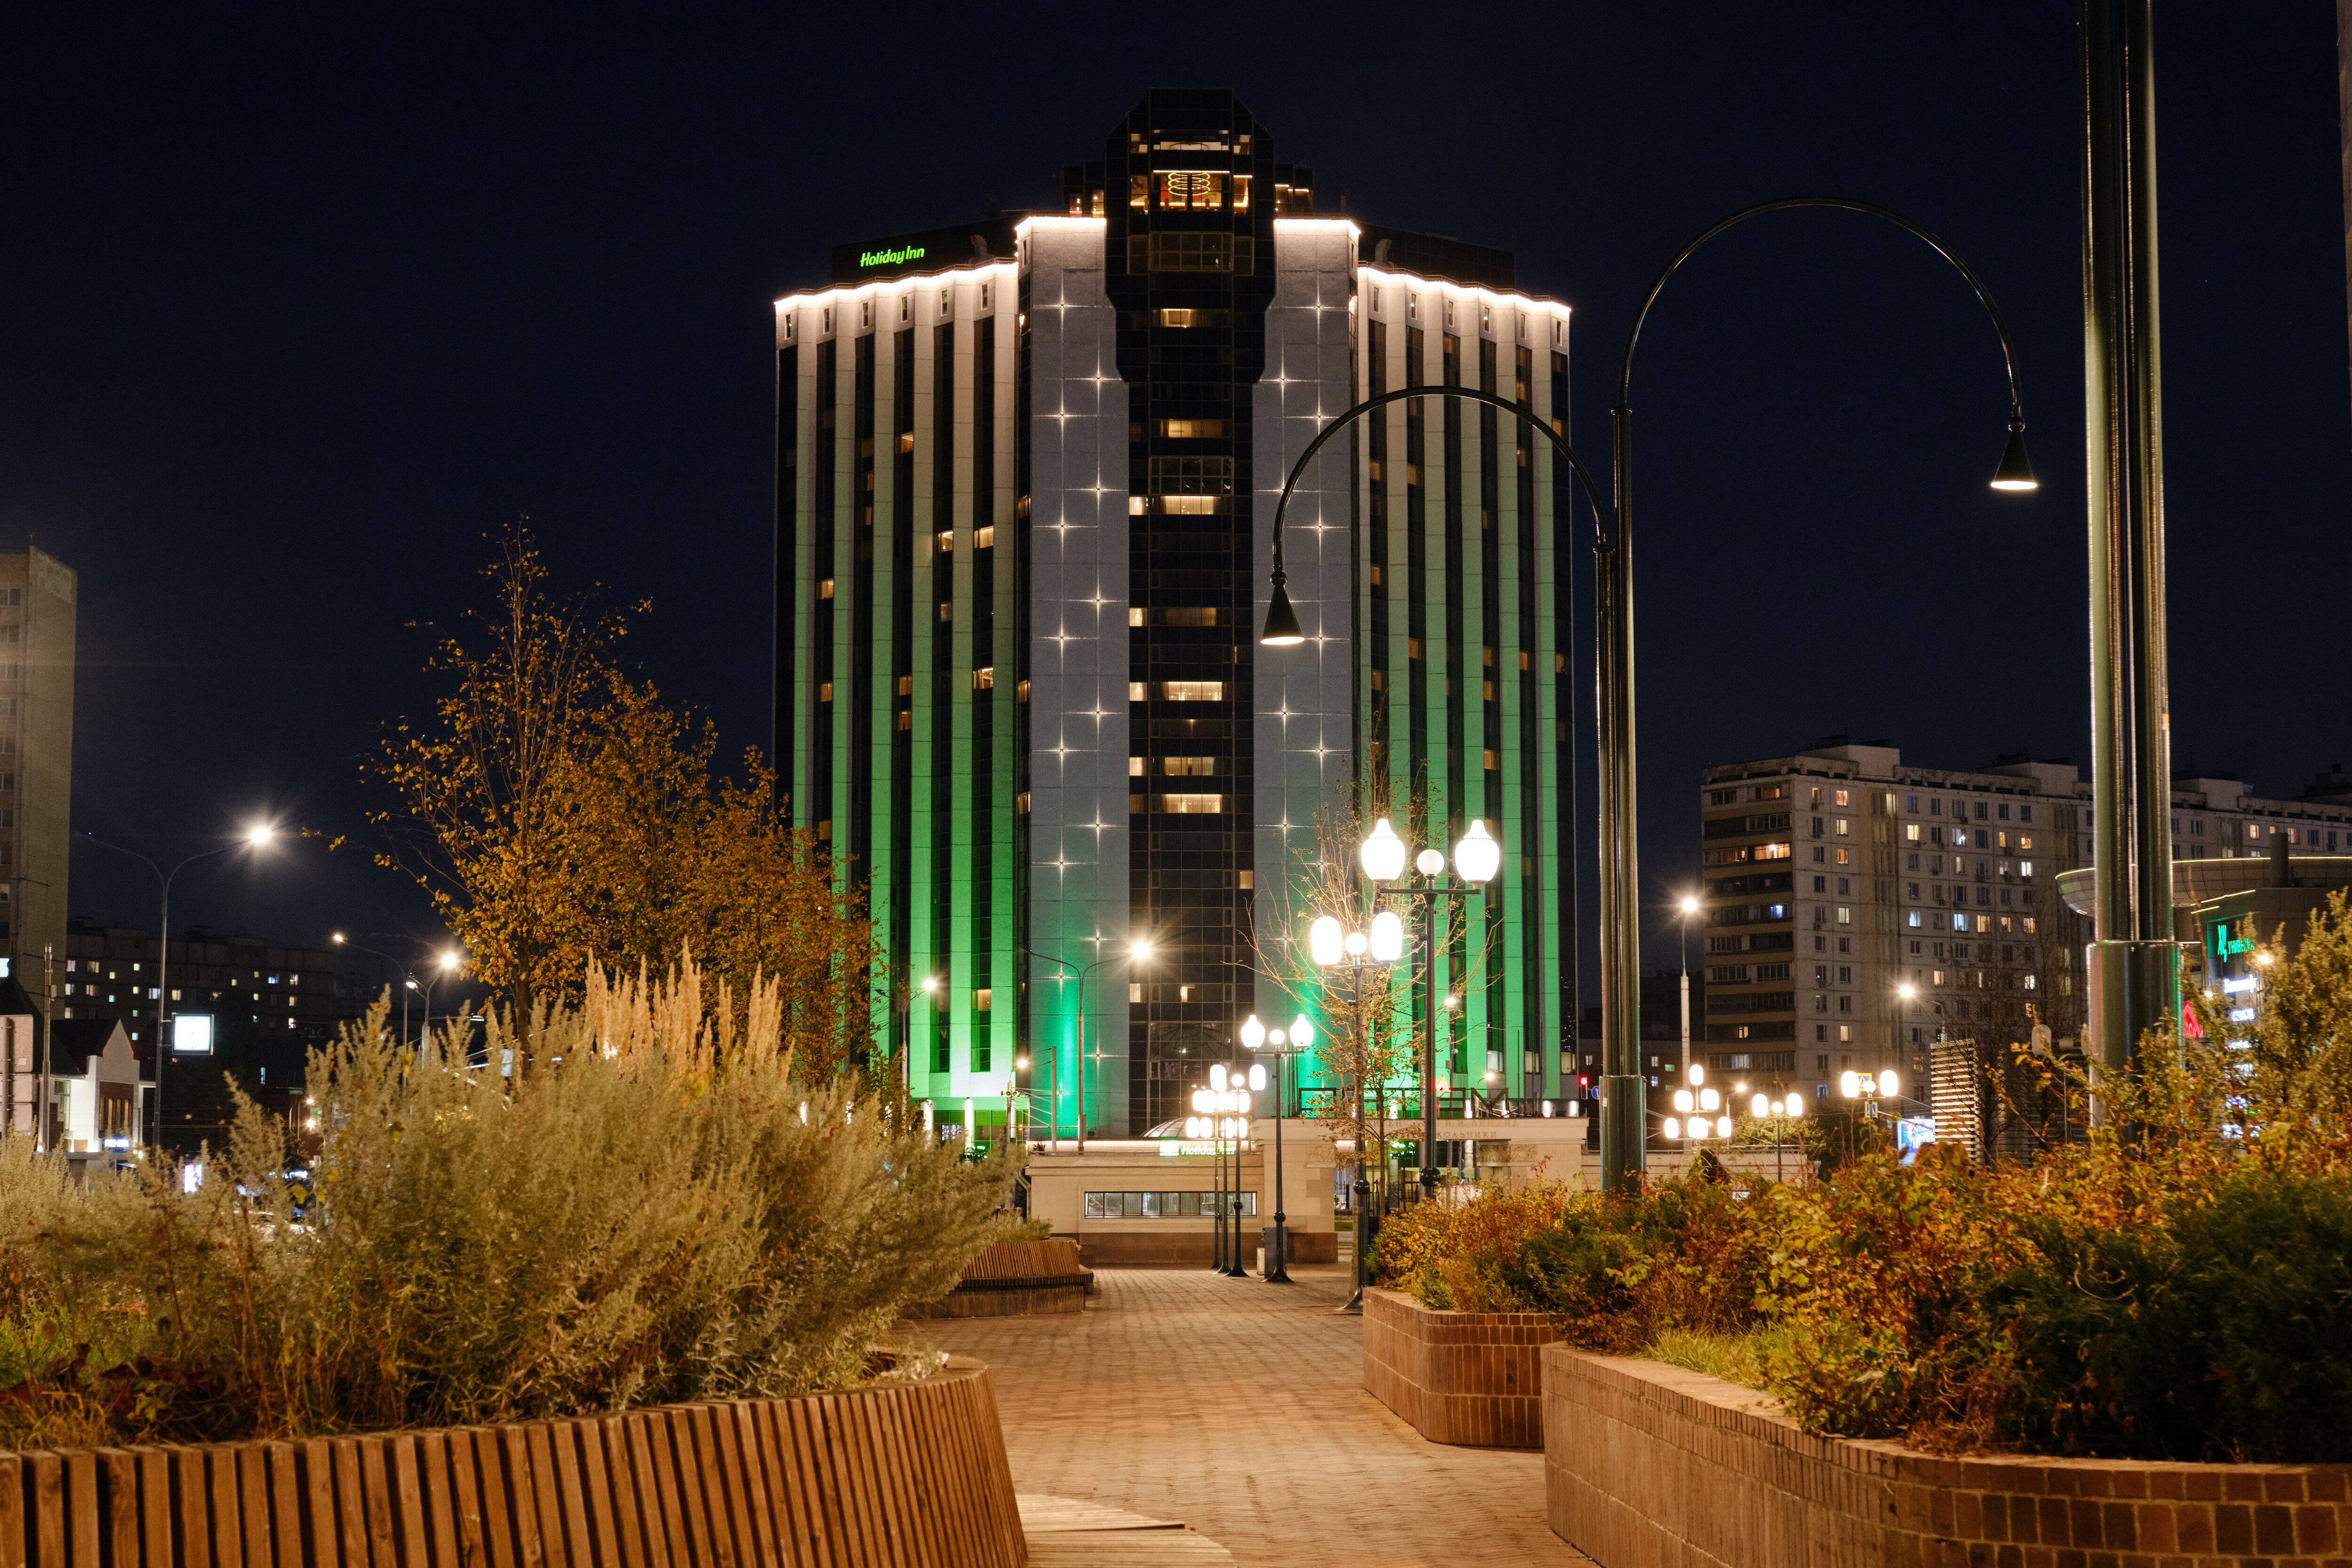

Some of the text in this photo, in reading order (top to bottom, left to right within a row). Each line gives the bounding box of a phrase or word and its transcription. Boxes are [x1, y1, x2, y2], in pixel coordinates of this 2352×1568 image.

[860, 246, 925, 267] Holiday Inn
[1181, 1144, 1216, 1156] Holiday
